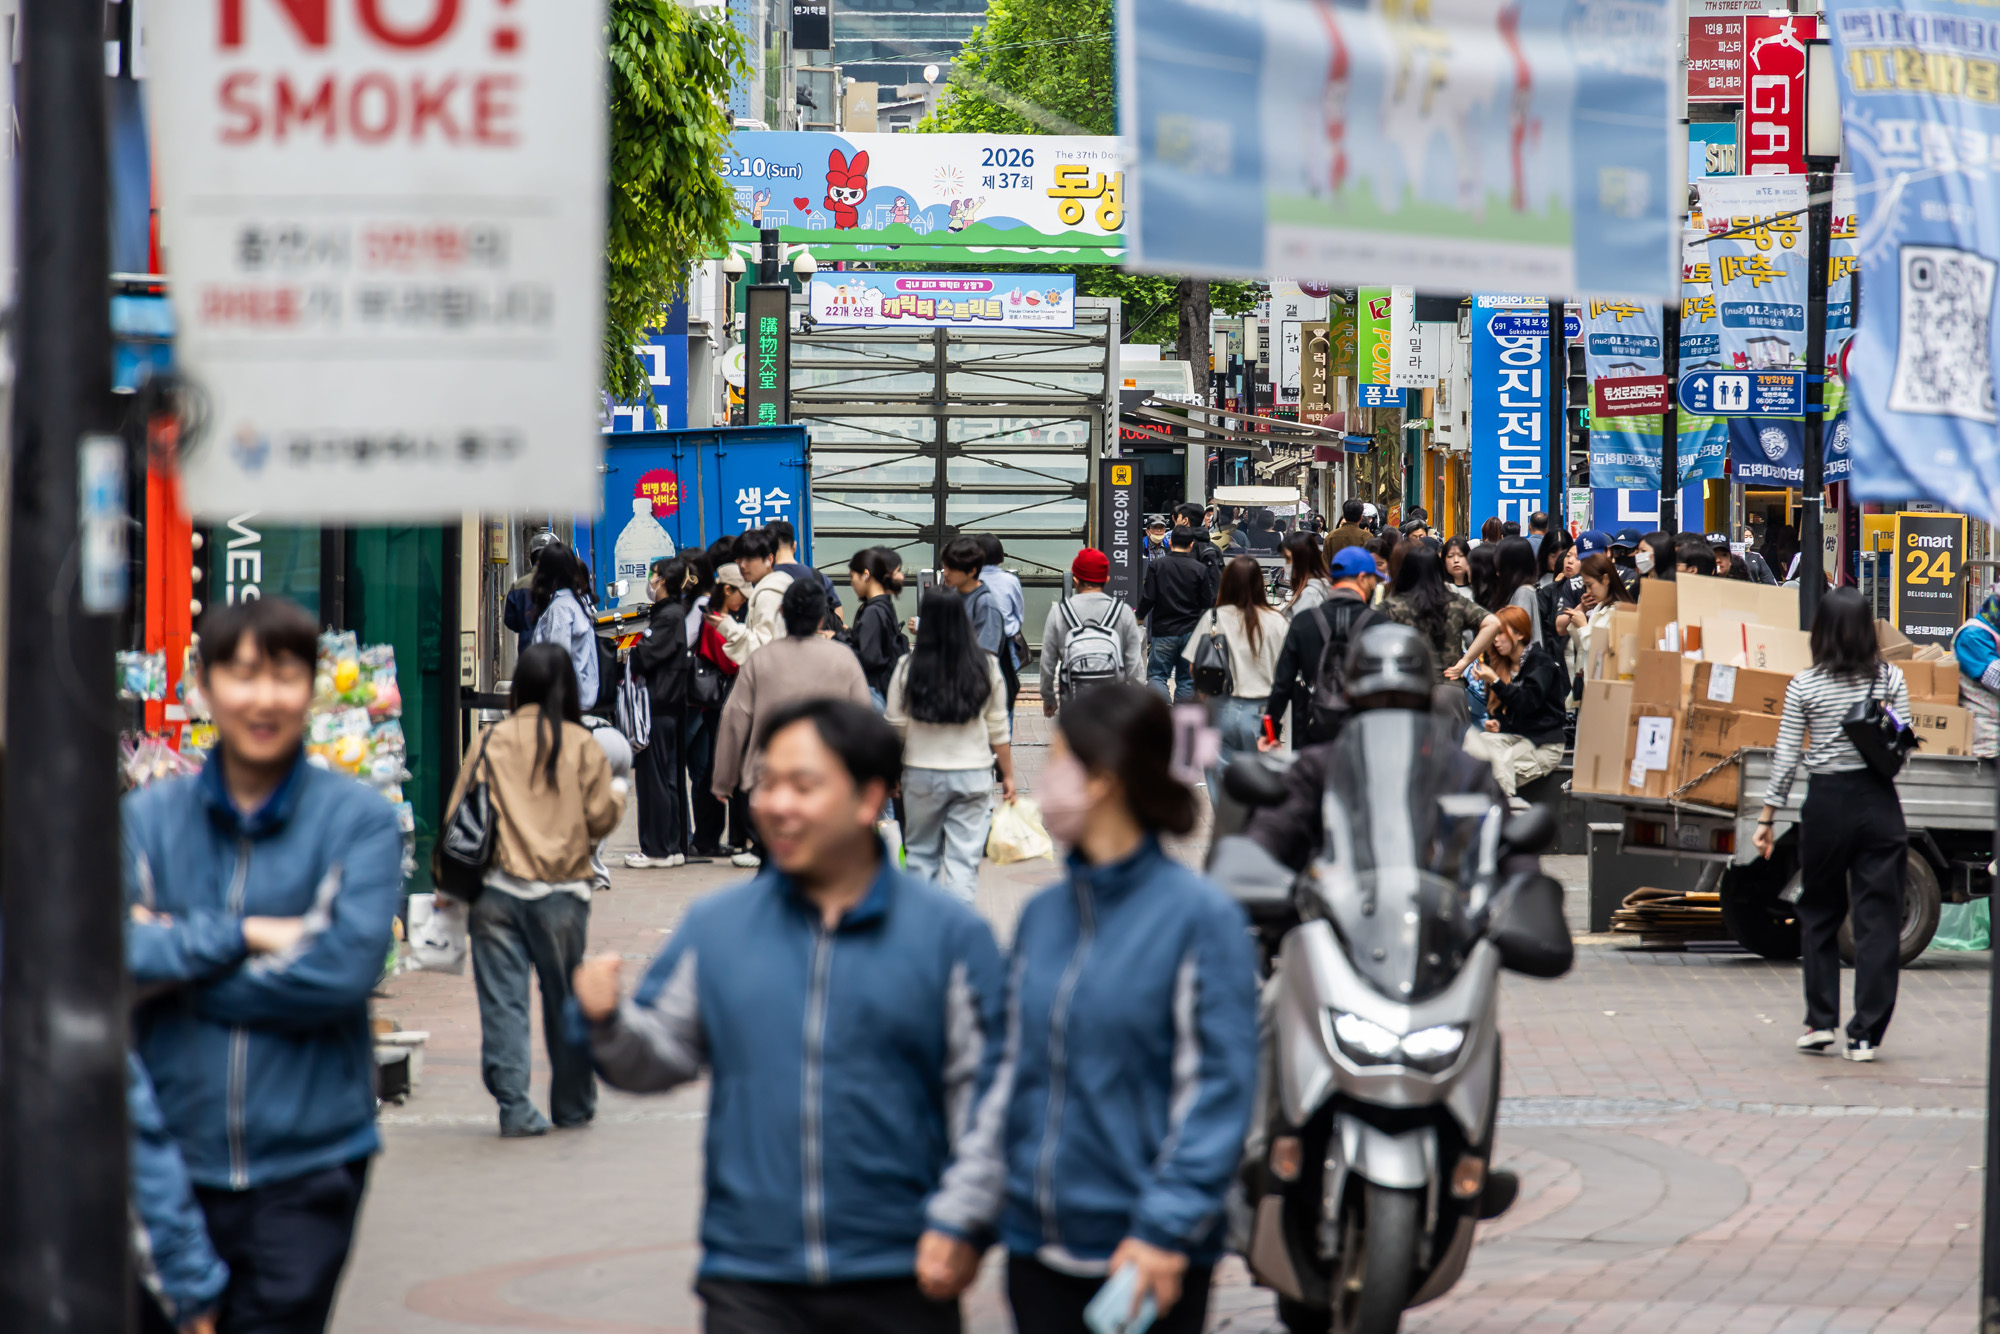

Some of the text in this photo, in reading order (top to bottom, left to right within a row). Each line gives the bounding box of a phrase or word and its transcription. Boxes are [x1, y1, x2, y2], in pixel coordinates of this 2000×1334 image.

[1719, 1, 1740, 10] STREET
[1743, 0, 1762, 9] PIZZA
[1704, 23, 1741, 35] 1인용 피자
[1718, 41, 1741, 52] 파스타
[216, 70, 520, 146] SMOKE
[981, 147, 1034, 168] 2026
[1055, 150, 1073, 160] The
[1076, 150, 1098, 160] 37th
[982, 172, 1033, 190] 제 37회
[825, 306, 875, 318] 22개 상점
[882, 295, 1003, 321] 캐릭터 스트리트
[1313, 352, 1327, 397] 럭셔리
[1306, 402, 1331, 411] 귀금속
[642, 482, 678, 495] 빈병 회수
[652, 495, 679, 506] 서비스
[735, 487, 791, 515] 생수
[1907, 533, 1954, 549] emart
[618, 563, 648, 579] 스파클
[1906, 550, 1956, 586] 24
[1907, 591, 1953, 599] DELICIOUS IDEA
